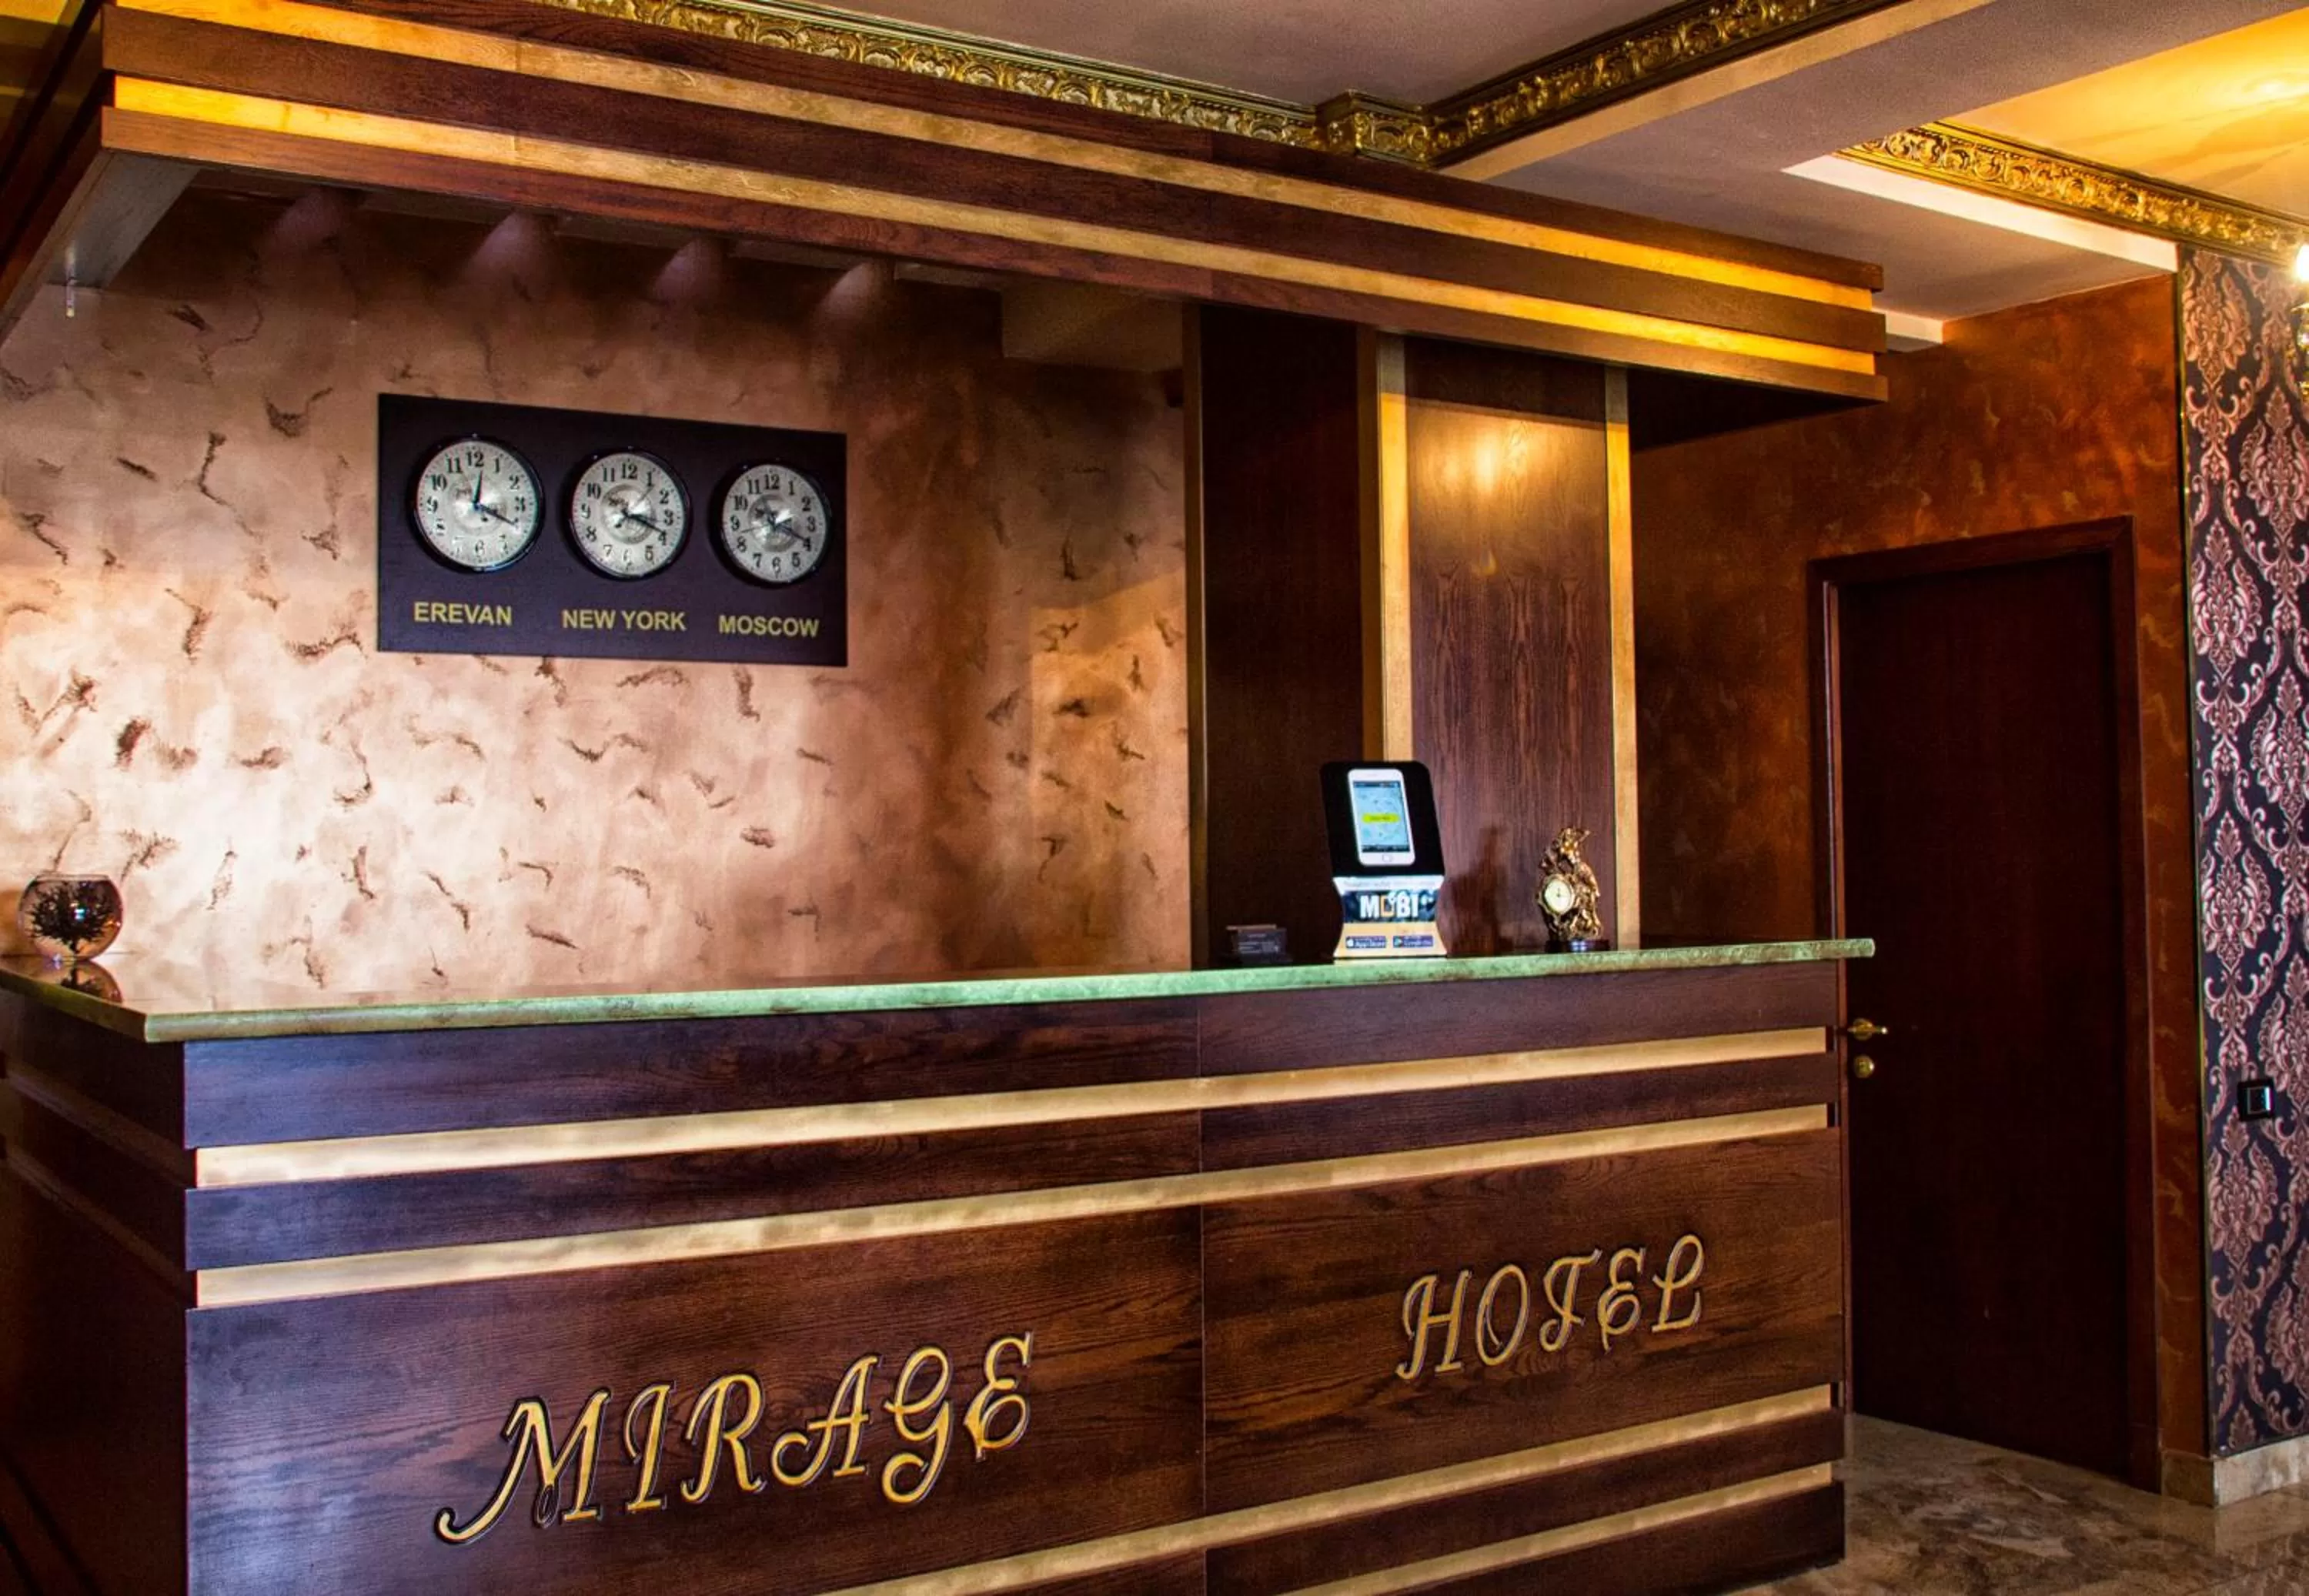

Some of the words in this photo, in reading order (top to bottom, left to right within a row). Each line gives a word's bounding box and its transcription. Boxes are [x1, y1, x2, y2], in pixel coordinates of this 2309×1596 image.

[446, 458, 463, 474] 11
[466, 451, 484, 467] 12
[495, 459, 501, 472] 1
[603, 468, 615, 482] 11
[622, 463, 637, 480] 12
[646, 472, 654, 487] 1
[431, 474, 448, 491] 10
[510, 475, 520, 490] 2
[747, 479, 762, 495] 11
[764, 474, 780, 490] 12
[788, 481, 795, 496] 1
[587, 483, 601, 499] 10
[660, 489, 669, 505] 2
[427, 497, 438, 513] 9
[734, 495, 749, 511] 10
[802, 496, 811, 512] 2
[581, 504, 590, 519] 9
[664, 509, 673, 526] 3
[730, 516, 740, 530] 9
[807, 516, 816, 533] 3
[586, 526, 596, 542] 8
[603, 544, 613, 557] 7
[737, 536, 747, 553] 8
[644, 546, 653, 561] 5
[753, 553, 762, 568] 7
[791, 553, 801, 568] 5
[413, 601, 513, 626] EREVAN
[562, 609, 617, 629] NEW
[621, 611, 687, 632] YORK
[718, 615, 820, 638] MOSCOW
[435, 1334, 1034, 1543] MIRAGE
[1395, 1234, 1705, 1380] HOTEL
